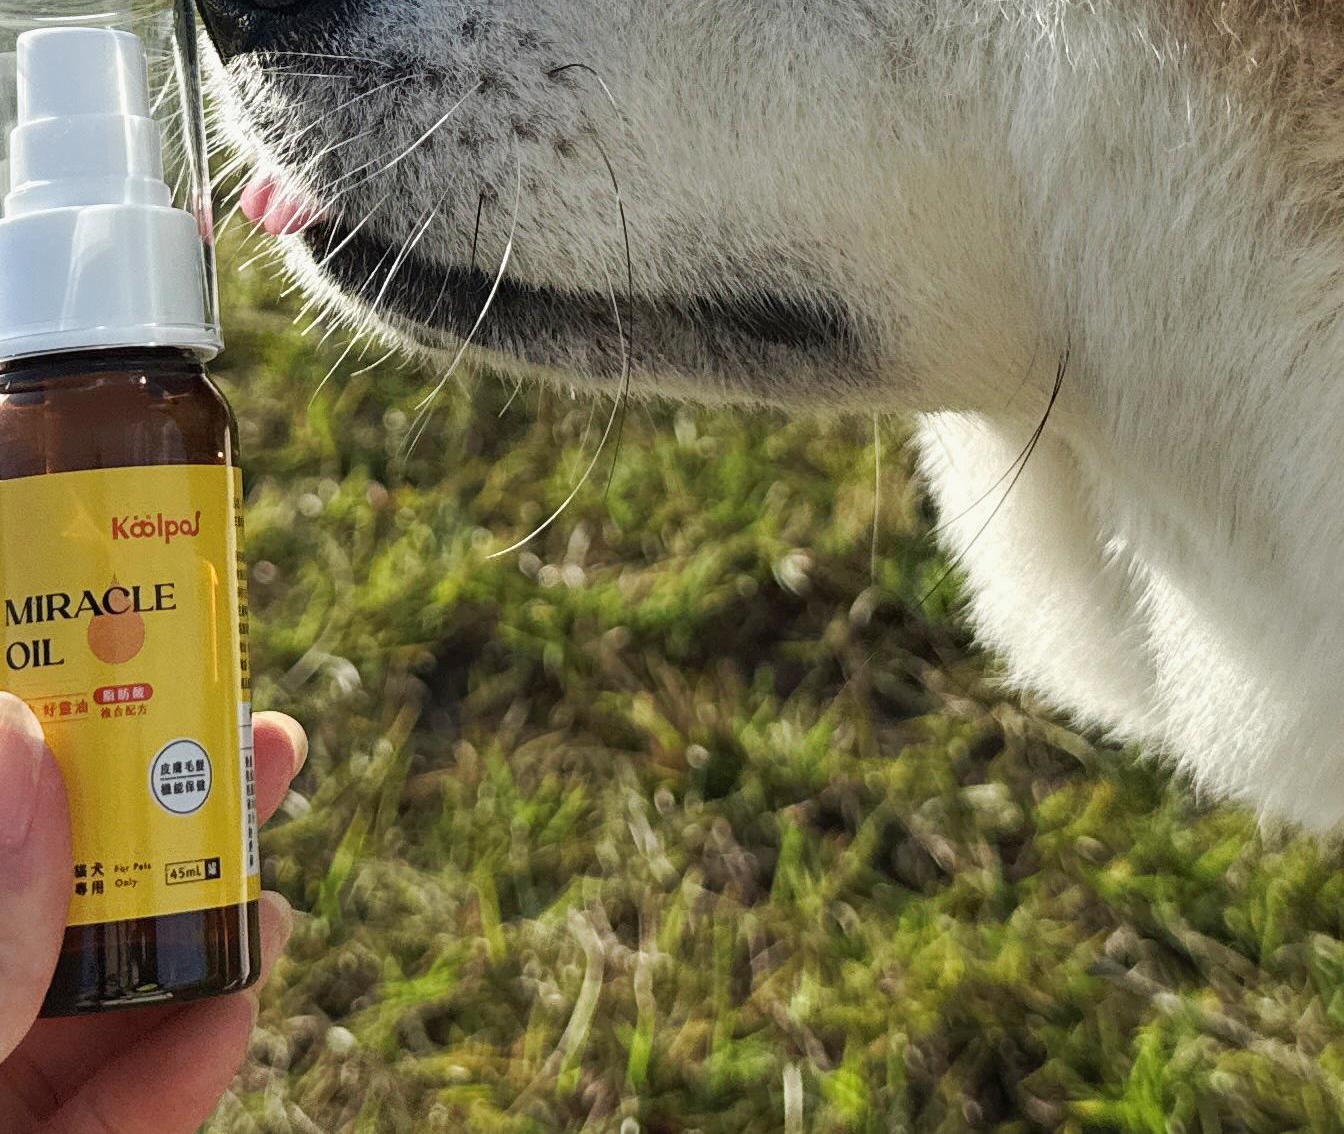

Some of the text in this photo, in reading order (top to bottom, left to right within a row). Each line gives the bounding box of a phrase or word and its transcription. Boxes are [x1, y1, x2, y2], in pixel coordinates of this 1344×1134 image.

[4, 582, 177, 627] MIRACLE
[5, 638, 65, 671] OIL
[113, 877, 139, 889] Only
